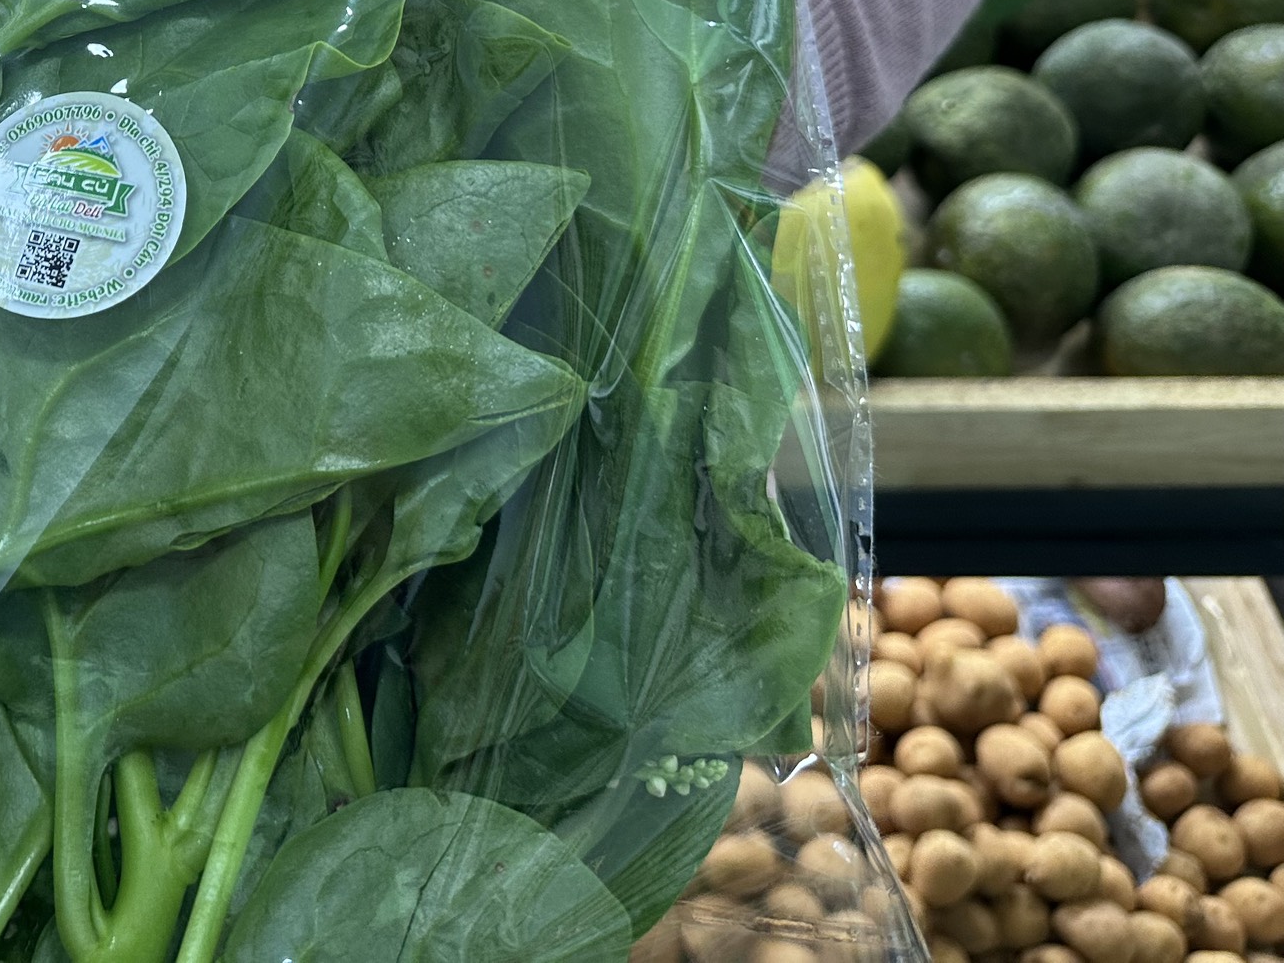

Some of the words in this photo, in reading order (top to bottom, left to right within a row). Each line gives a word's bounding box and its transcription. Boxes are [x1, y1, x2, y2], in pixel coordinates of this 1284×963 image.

[7, 103, 103, 142] 0869007796
[118, 113, 141, 139] Địa
[153, 161, 175, 208] 4/294
[74, 201, 104, 219] Deli
[51, 278, 124, 308] Website:
